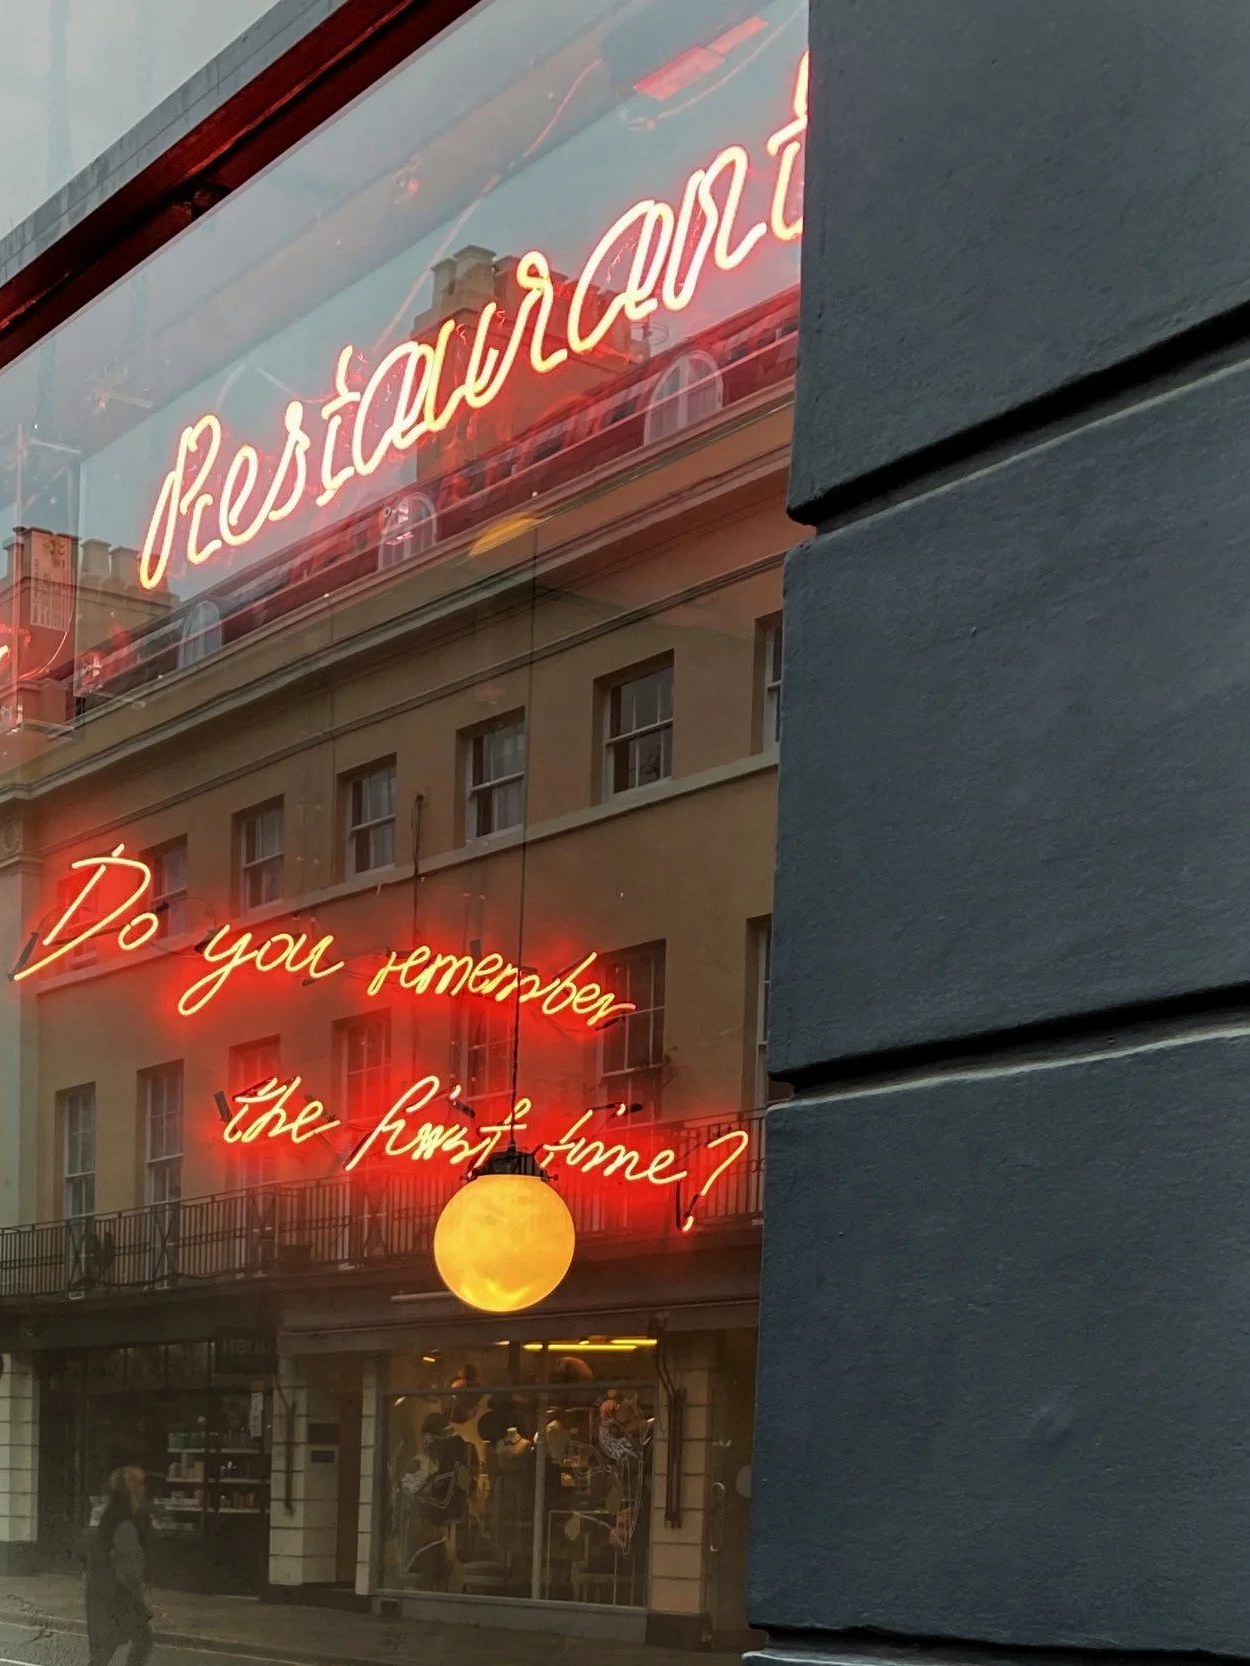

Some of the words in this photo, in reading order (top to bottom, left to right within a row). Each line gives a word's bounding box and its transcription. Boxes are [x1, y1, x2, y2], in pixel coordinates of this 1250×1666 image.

[12, 843, 160, 982] Do
[177, 924, 344, 1016] you
[367, 951, 634, 1027] remember
[225, 1076, 340, 1145] the
[346, 1075, 532, 1172] first
